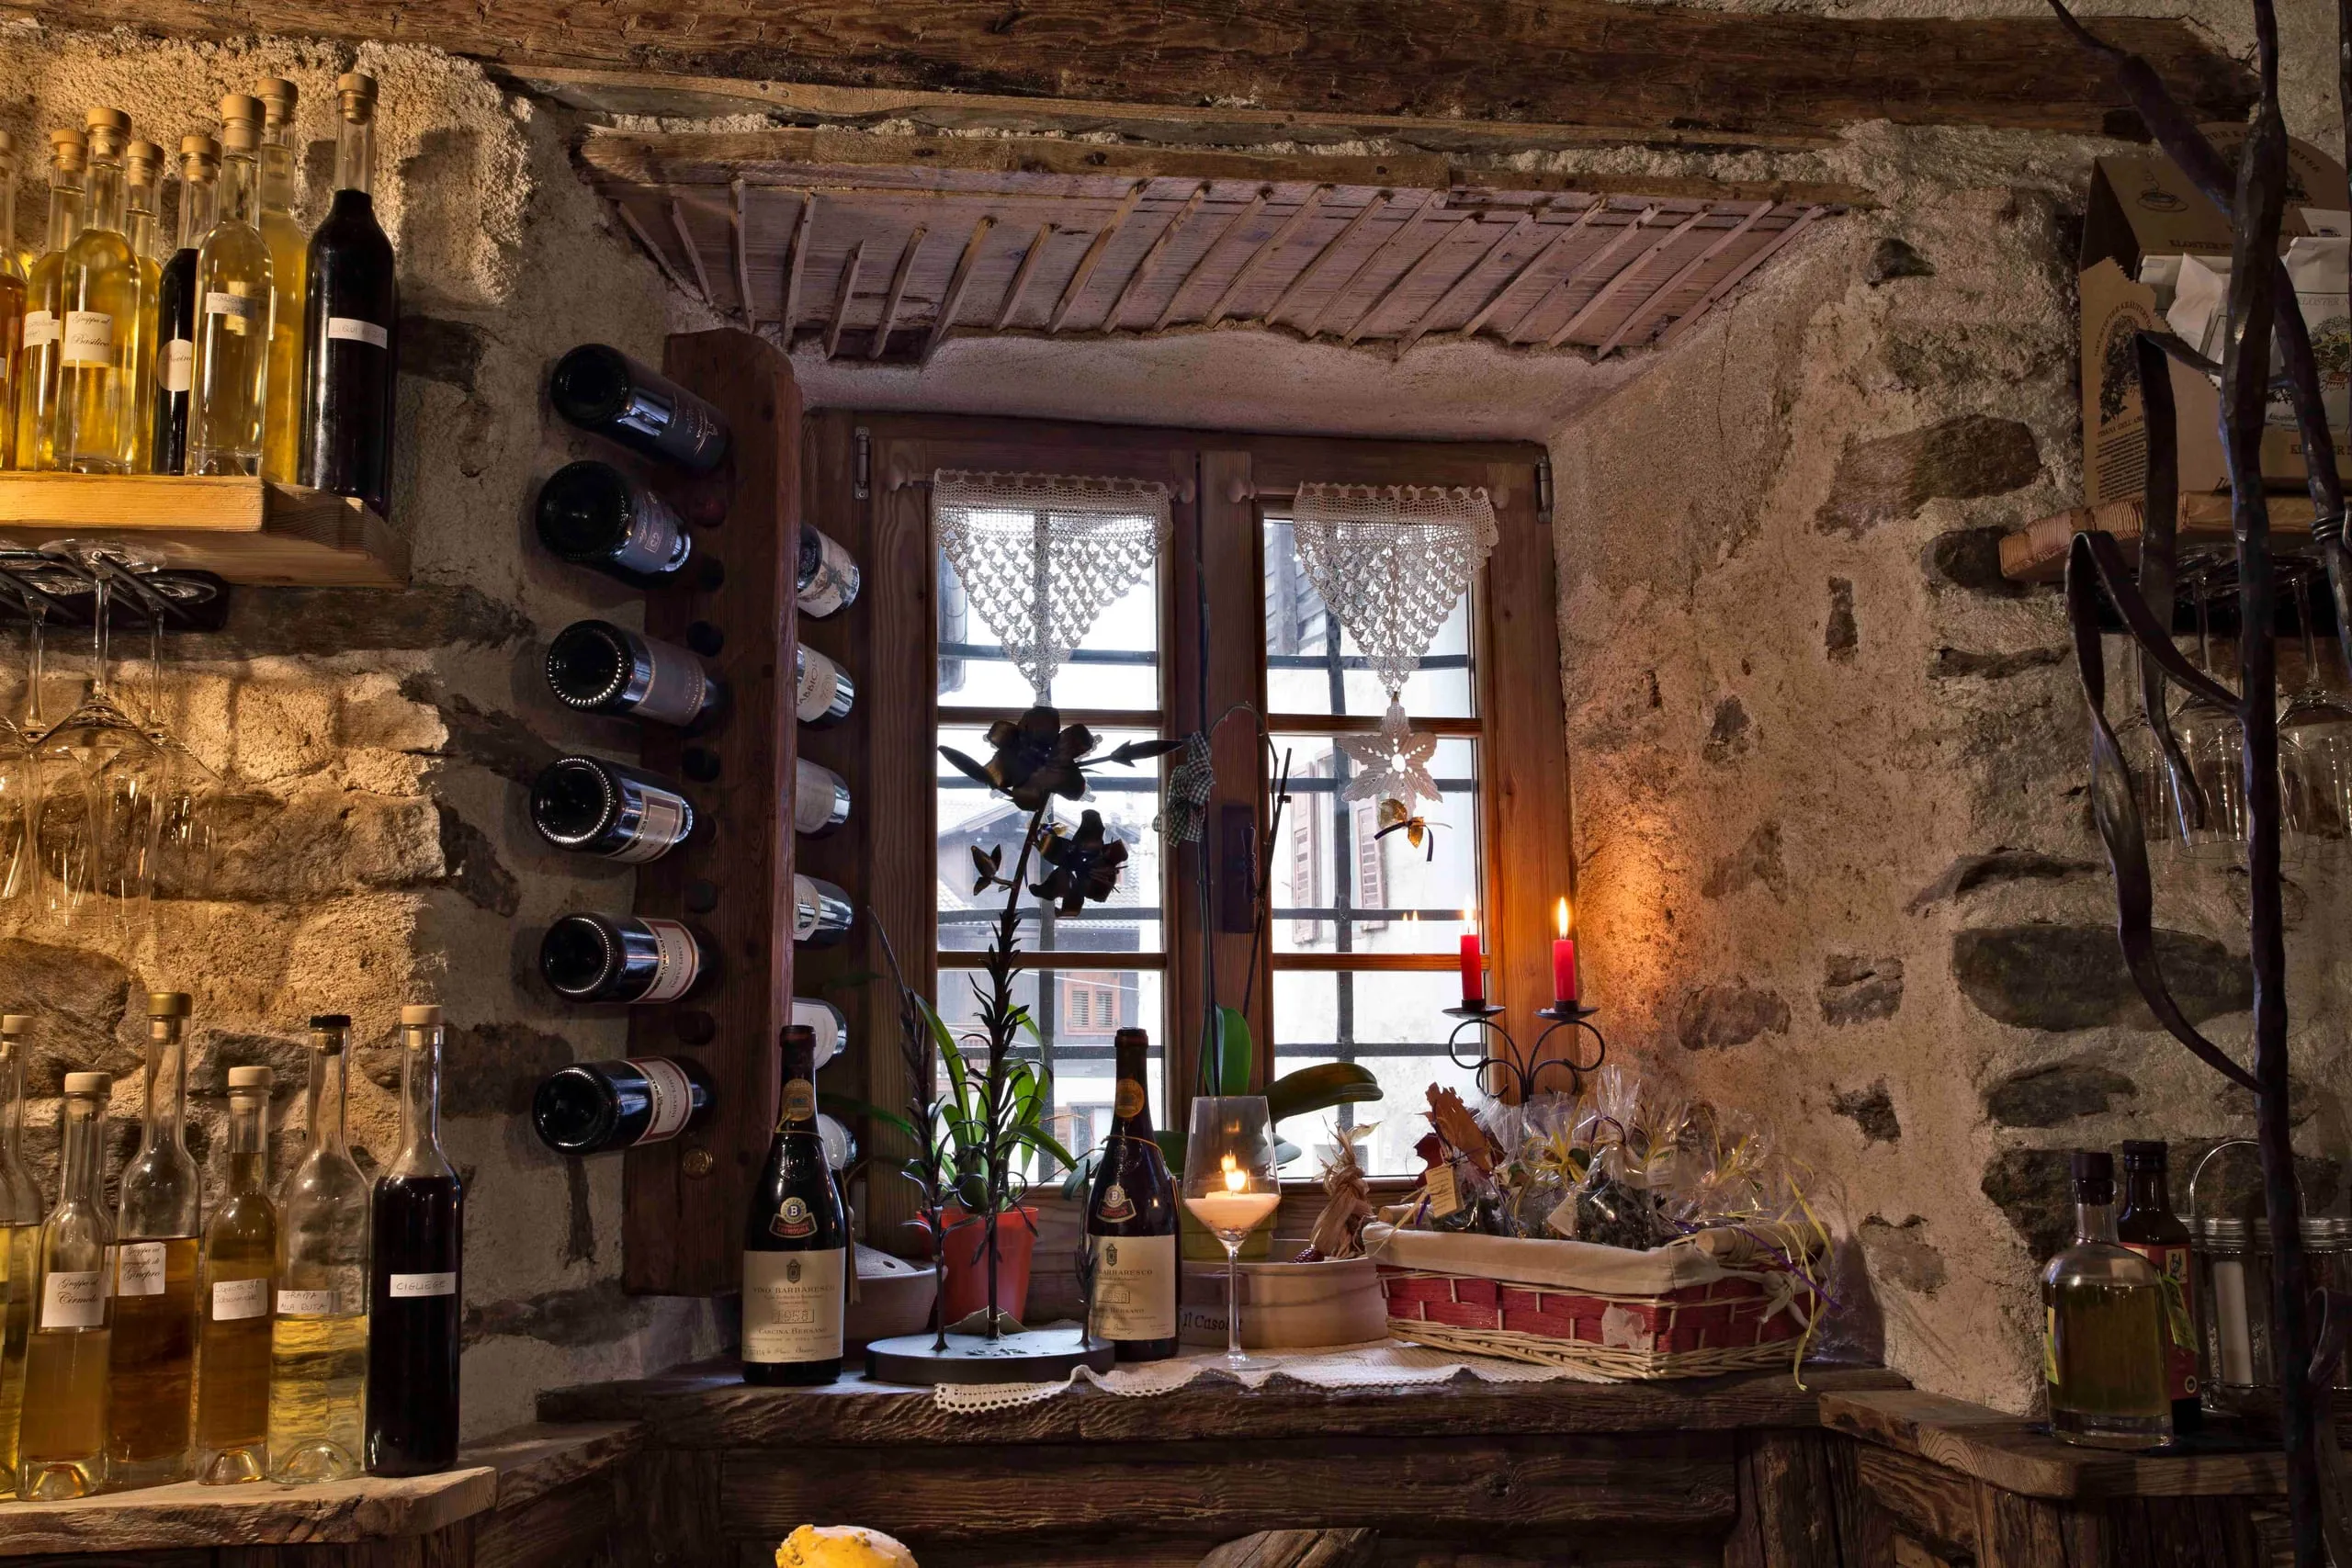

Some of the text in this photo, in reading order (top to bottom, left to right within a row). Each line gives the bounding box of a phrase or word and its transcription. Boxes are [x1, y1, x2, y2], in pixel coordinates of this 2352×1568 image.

[789, 1205, 798, 1216] B
[753, 1284, 836, 1295] VINO BARBARESCO
[1194, 1314, 1244, 1332] Casolt
